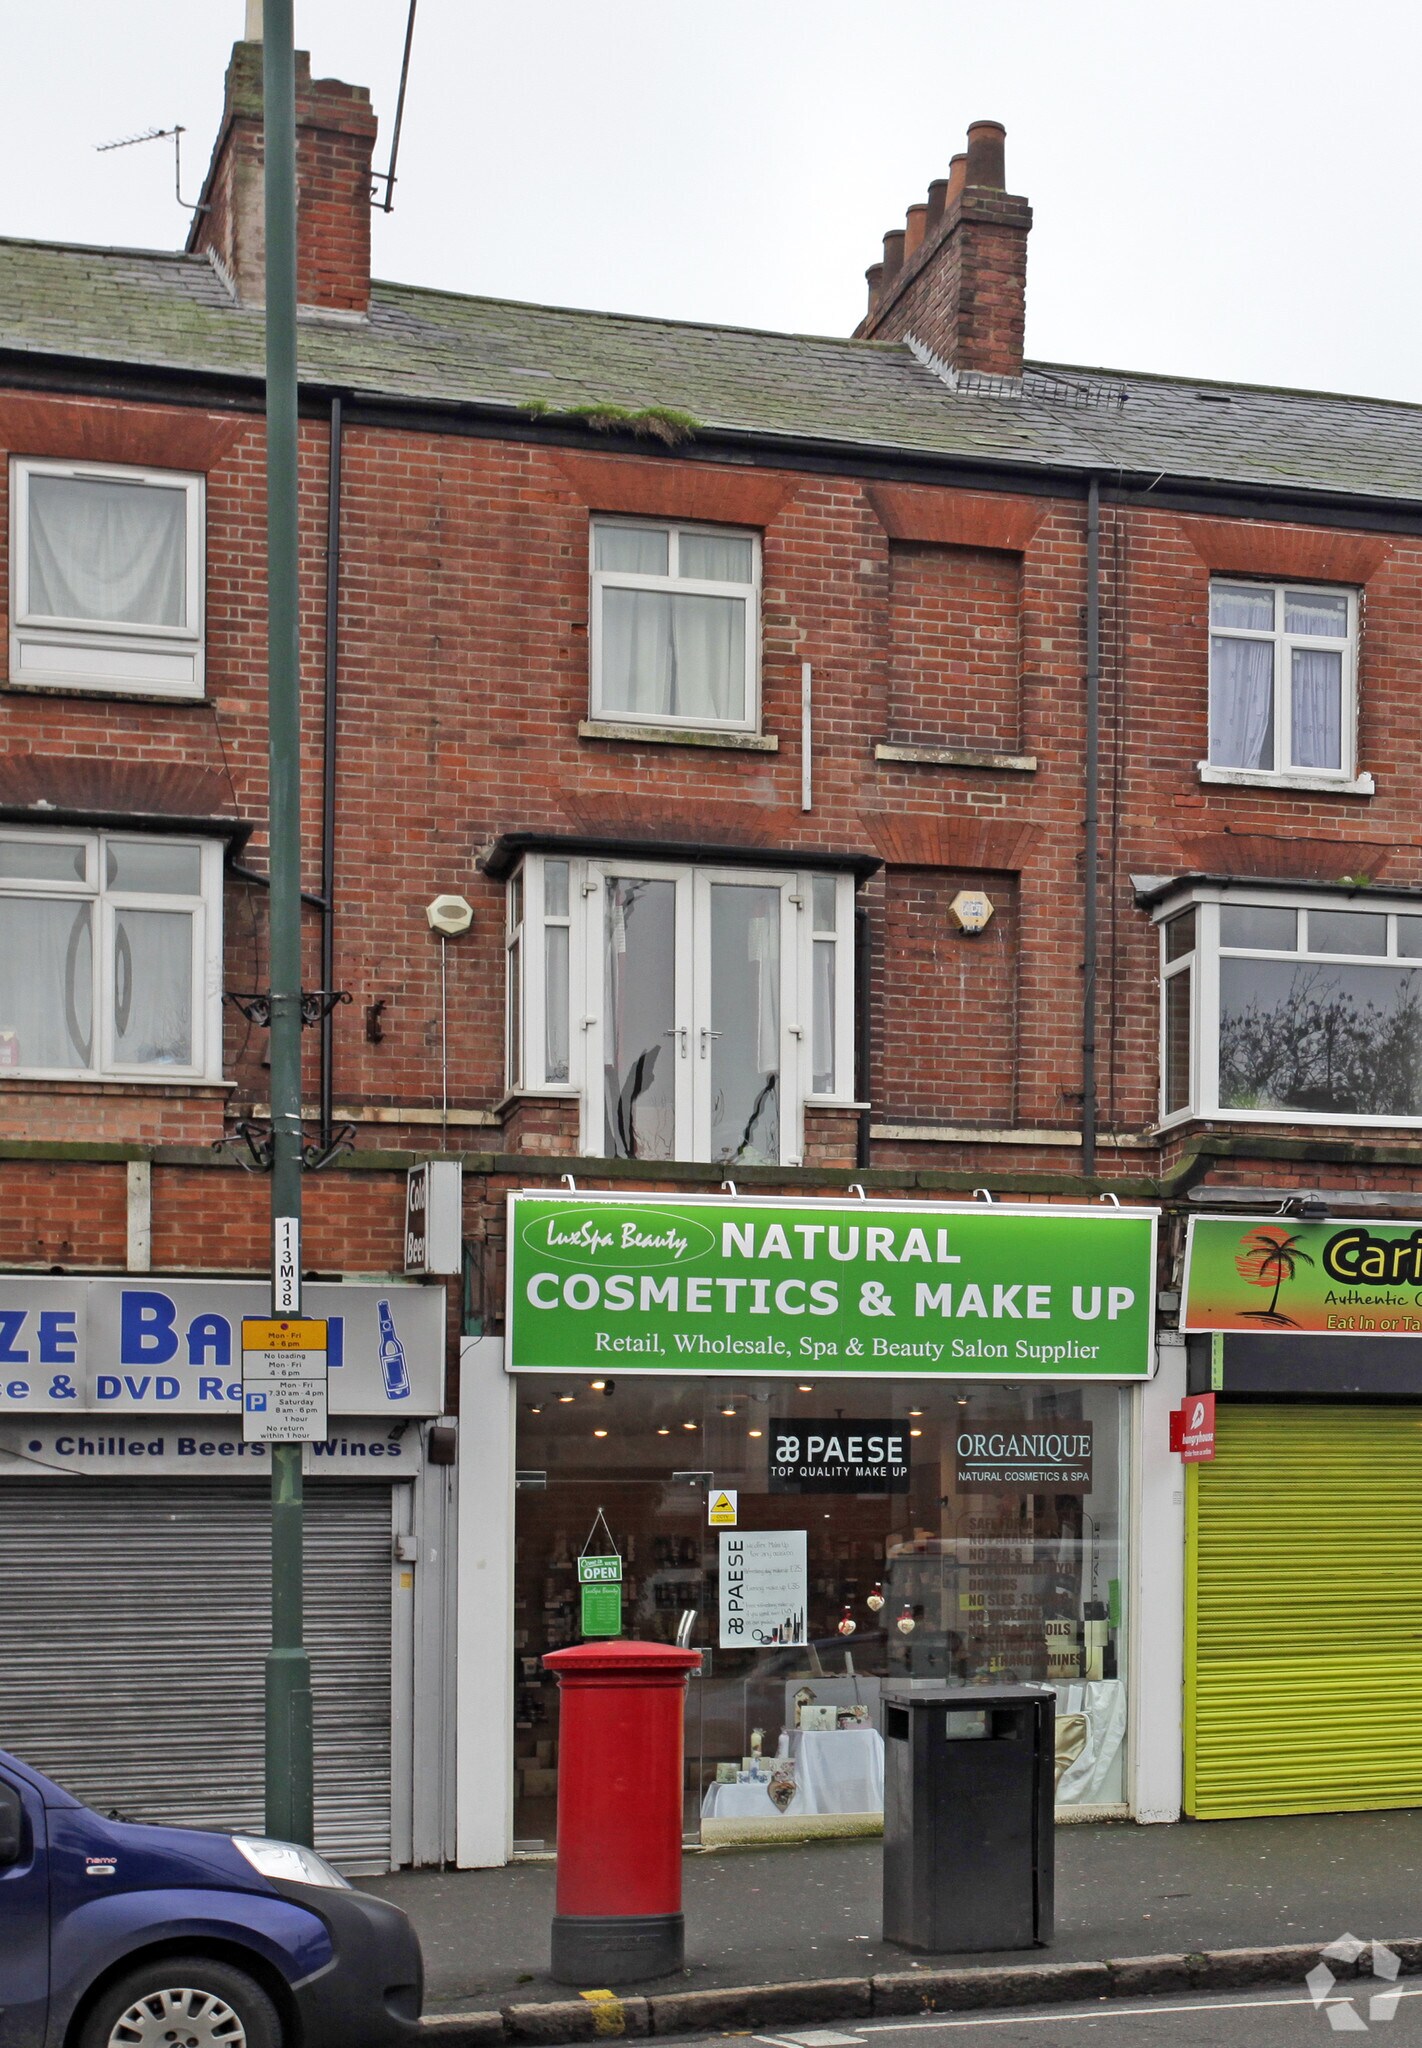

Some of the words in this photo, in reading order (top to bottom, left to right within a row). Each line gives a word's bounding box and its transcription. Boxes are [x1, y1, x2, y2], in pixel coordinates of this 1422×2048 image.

[410, 1177, 426, 1212] Cold
[407, 1232, 425, 1263] Beer
[547, 1220, 614, 1254] LuxSpa
[621, 1223, 688, 1259] Beauty
[722, 1222, 961, 1263] NATURAL
[1327, 1233, 1422, 1280] Cari
[526, 1272, 839, 1316] COSMETICS
[859, 1281, 896, 1317] &
[915, 1283, 1051, 1319] MAKE
[1072, 1286, 1135, 1320] UP
[1324, 1289, 1408, 1306] Authentic
[1327, 1314, 1354, 1330] Eat
[1359, 1315, 1376, 1330] In
[1380, 1318, 1399, 1330] or
[277, 1353, 306, 1361] loading
[595, 1332, 666, 1356] Retail,
[674, 1334, 792, 1358] Wholesale,
[799, 1336, 838, 1360] Spa
[845, 1337, 864, 1356] &
[872, 1338, 944, 1361] Beauty
[952, 1339, 1009, 1358] Salon
[1016, 1340, 1100, 1363] Supplier
[48, 1375, 78, 1399] &
[97, 1376, 181, 1400] DVD
[251, 1396, 264, 1410] P
[55, 1437, 164, 1456] Chilled
[178, 1438, 265, 1456] Beers
[312, 1439, 402, 1456] Wines
[807, 1436, 903, 1463] PAESE
[957, 1433, 1091, 1462] ORGANIQUE
[771, 1466, 795, 1477] TOP
[800, 1466, 850, 1477] QUALITY
[855, 1466, 887, 1477] MAKE
[892, 1466, 907, 1477] UP
[958, 1471, 1002, 1481] NATURAL
[1004, 1471, 1059, 1481] COSMETICS
[1062, 1472, 1068, 1481] &
[1071, 1472, 1090, 1481] SPA
[584, 1567, 618, 1580] OPEN
[728, 1540, 744, 1611] PAESE
[969, 1594, 985, 1606] NO
[1046, 1623, 1071, 1636] OILS
